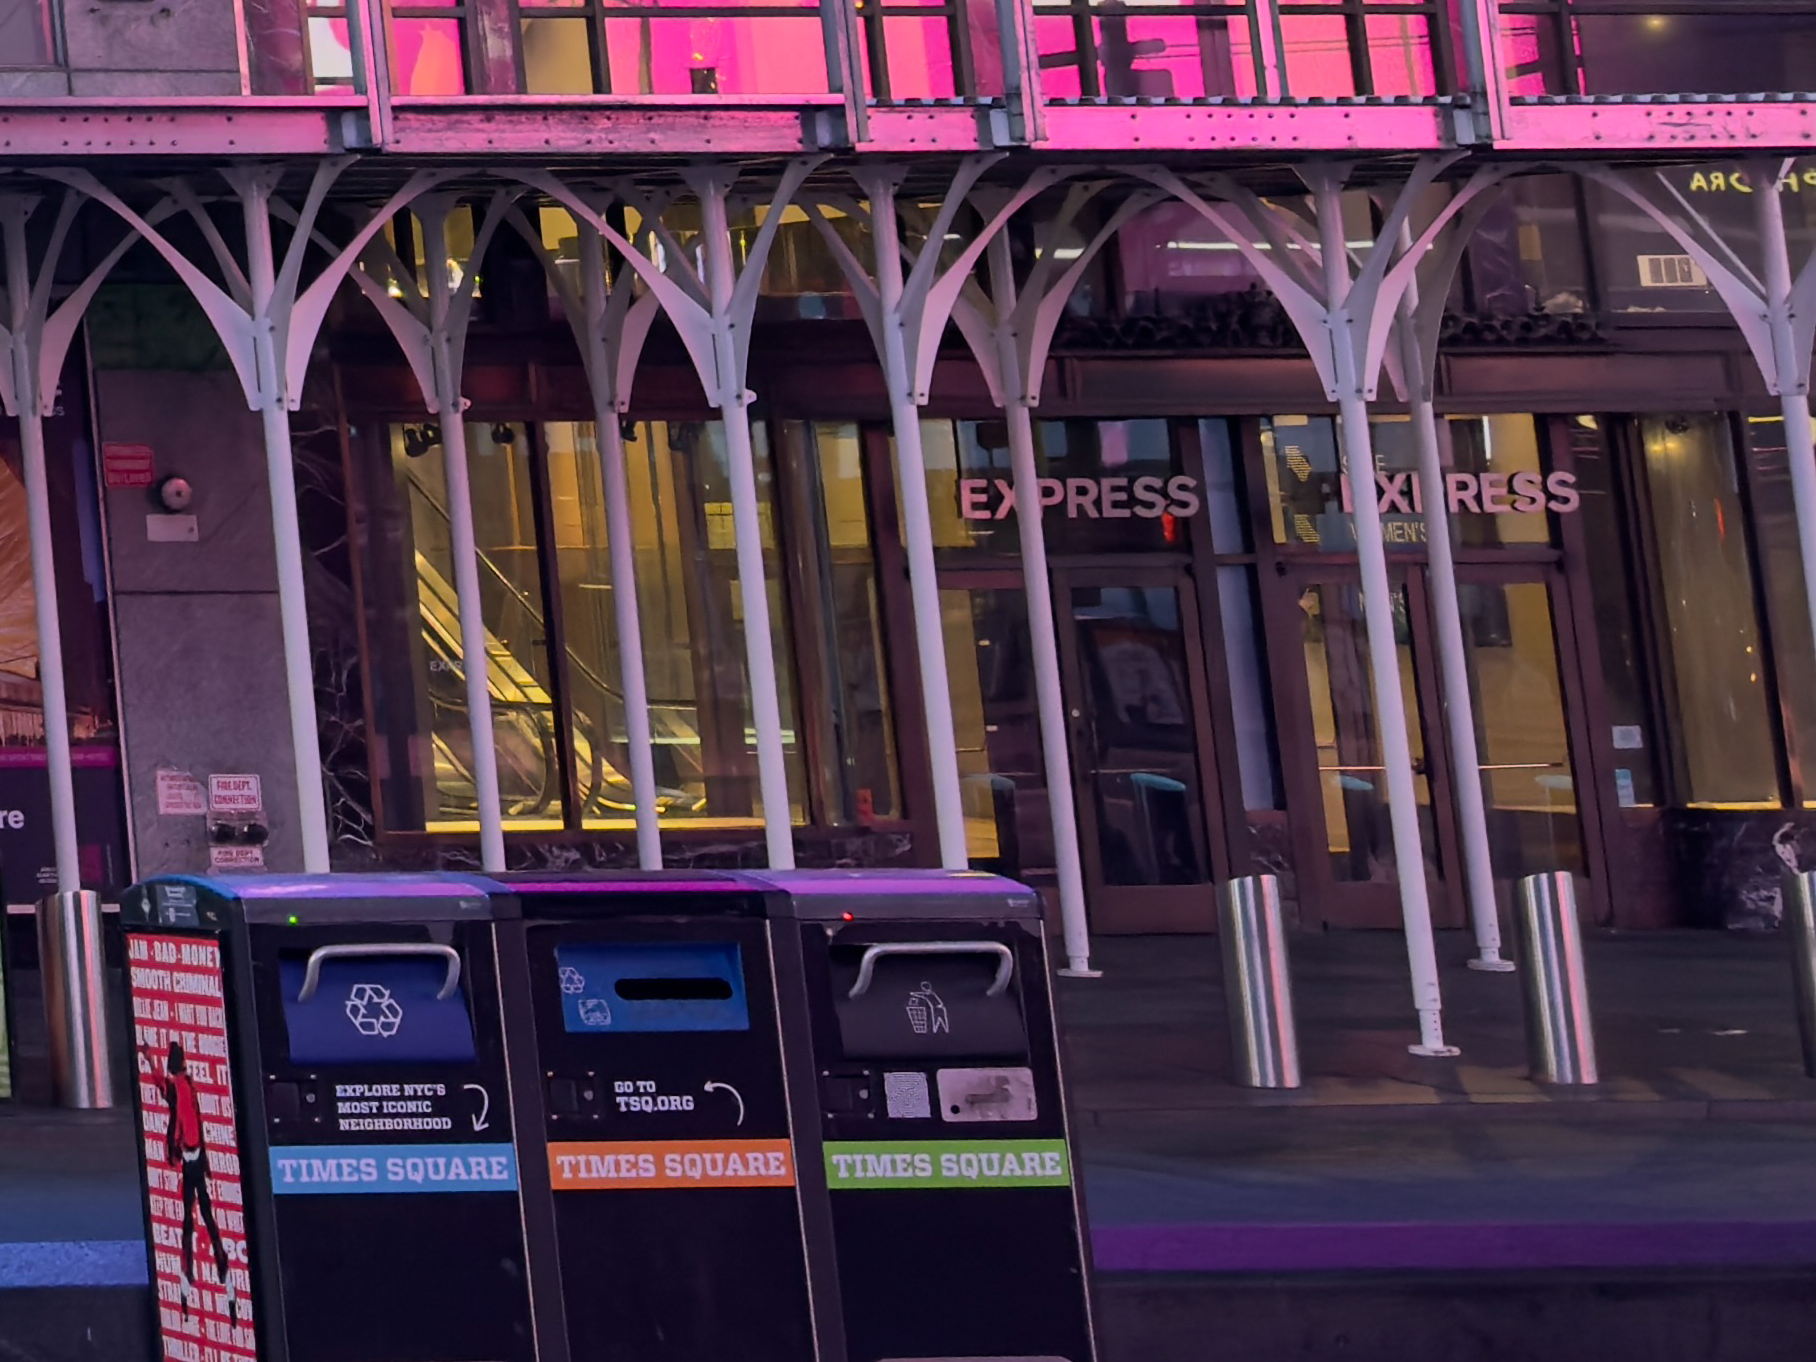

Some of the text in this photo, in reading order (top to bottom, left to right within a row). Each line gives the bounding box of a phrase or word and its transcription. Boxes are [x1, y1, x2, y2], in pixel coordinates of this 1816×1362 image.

[216, 780, 233, 791] FIRE
[214, 794, 257, 805] CONNECTION
[129, 939, 149, 961] JAM
[153, 941, 177, 964] BAD
[130, 967, 222, 997] SMOOTH CRIMINAL
[335, 1083, 447, 1098] EXPLORE NYC'S
[613, 1080, 657, 1094] GO TO
[337, 1100, 433, 1115] MOST ICONIC
[615, 1095, 696, 1114] TSQ.ORG
[339, 1117, 453, 1131] NEIGHBORHOOD
[276, 1156, 510, 1185] TIMES SQUARE
[556, 1151, 788, 1181] TIMES SQUARE
[831, 1151, 1063, 1181] TIMES SQUARE
